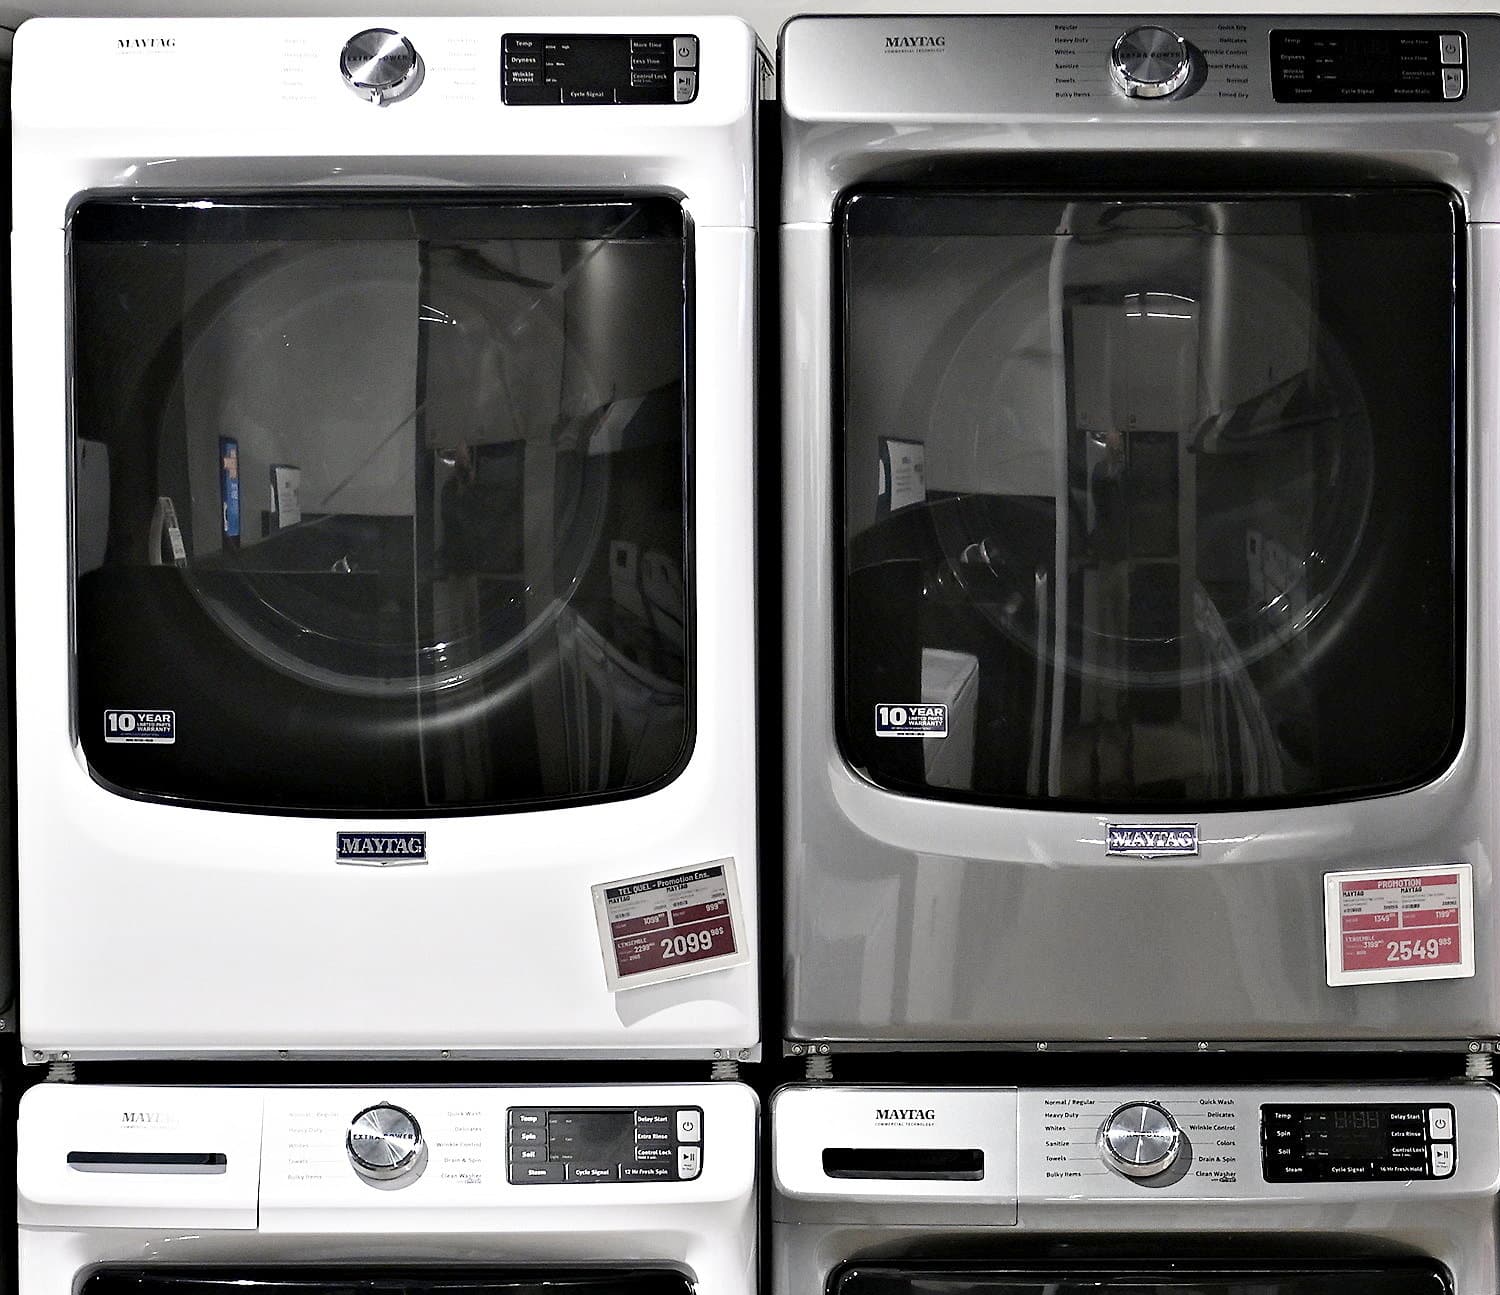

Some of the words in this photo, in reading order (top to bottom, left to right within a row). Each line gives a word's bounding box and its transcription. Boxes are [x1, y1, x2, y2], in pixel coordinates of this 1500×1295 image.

[118, 38, 175, 49] MAYTAG
[886, 37, 945, 47] MAYTAG
[138, 714, 170, 722] YEAR
[880, 707, 907, 725] 10
[909, 708, 943, 716] YEAR
[109, 713, 135, 731] 10
[341, 838, 422, 853] MAYTAG
[1112, 831, 1192, 847] MAYTAG
[633, 884, 651, 894] QUEL
[657, 876, 693, 888] Promotion
[695, 872, 710, 880] Ens.
[1378, 879, 1422, 889] PROMOTION
[661, 931, 712, 958] 2099
[1387, 939, 1439, 961] 2549
[876, 1110, 935, 1119] MAYTAG
